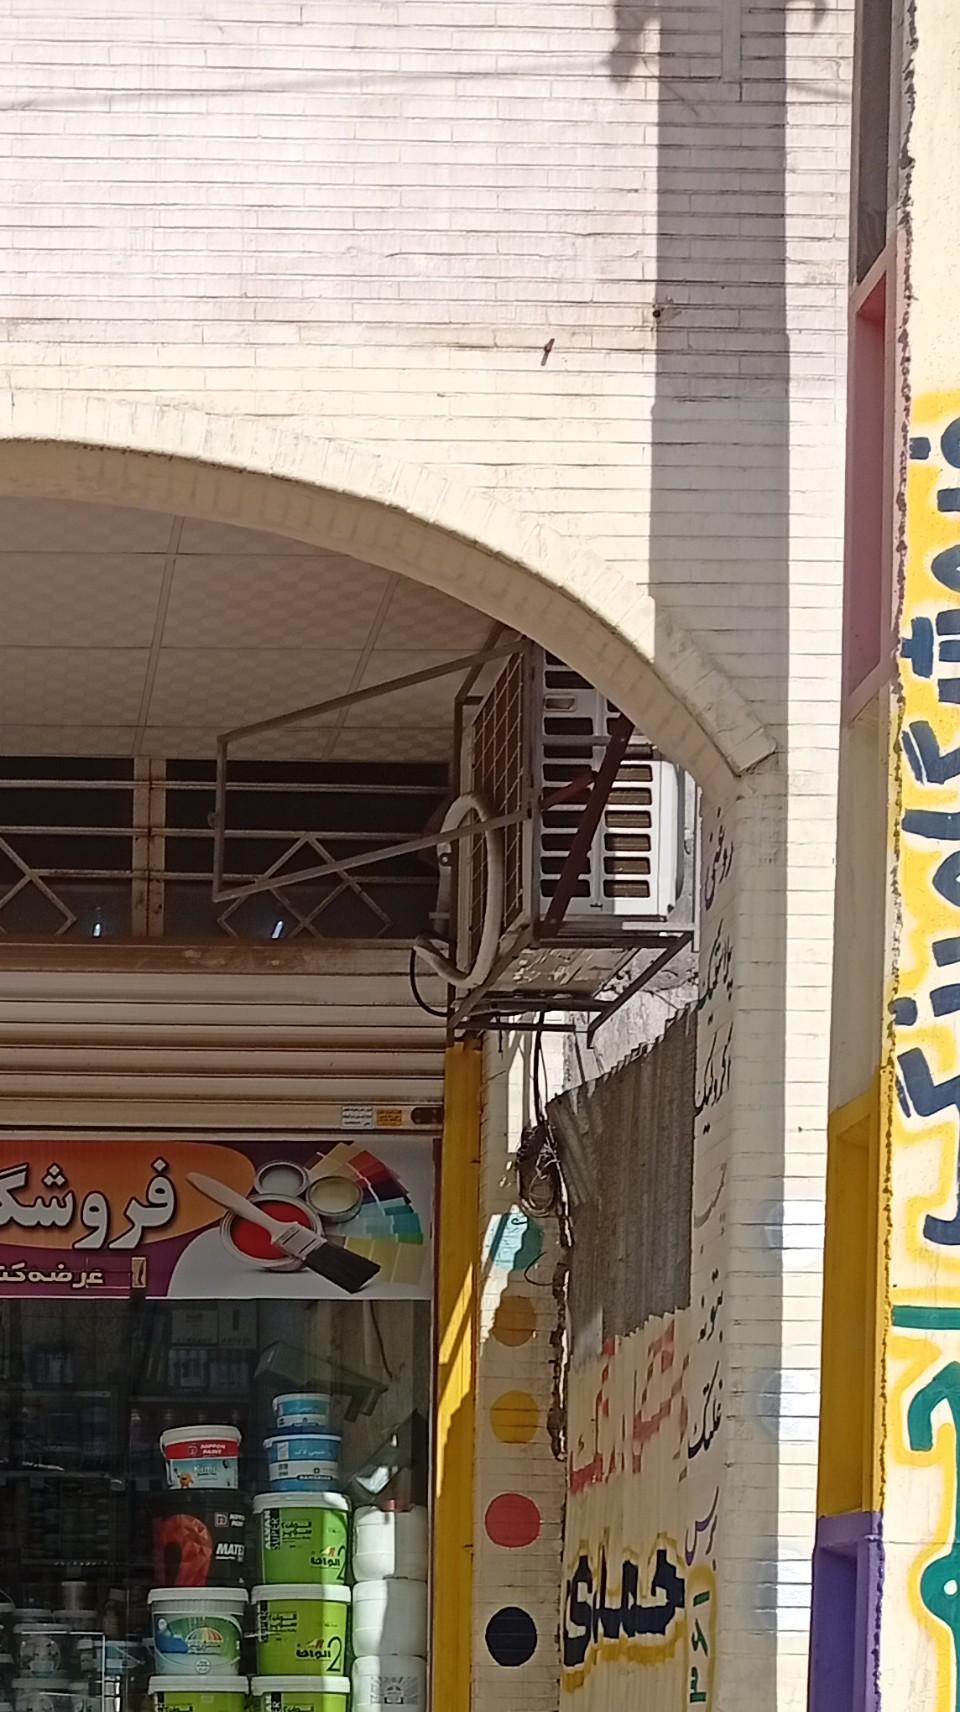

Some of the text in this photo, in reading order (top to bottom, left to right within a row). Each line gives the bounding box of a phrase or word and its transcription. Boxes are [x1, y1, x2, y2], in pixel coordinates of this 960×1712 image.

[704, 806, 734, 911] روغنی
[28, 1262, 105, 1288] عرضه
[325, 1635, 343, 1673] 2
